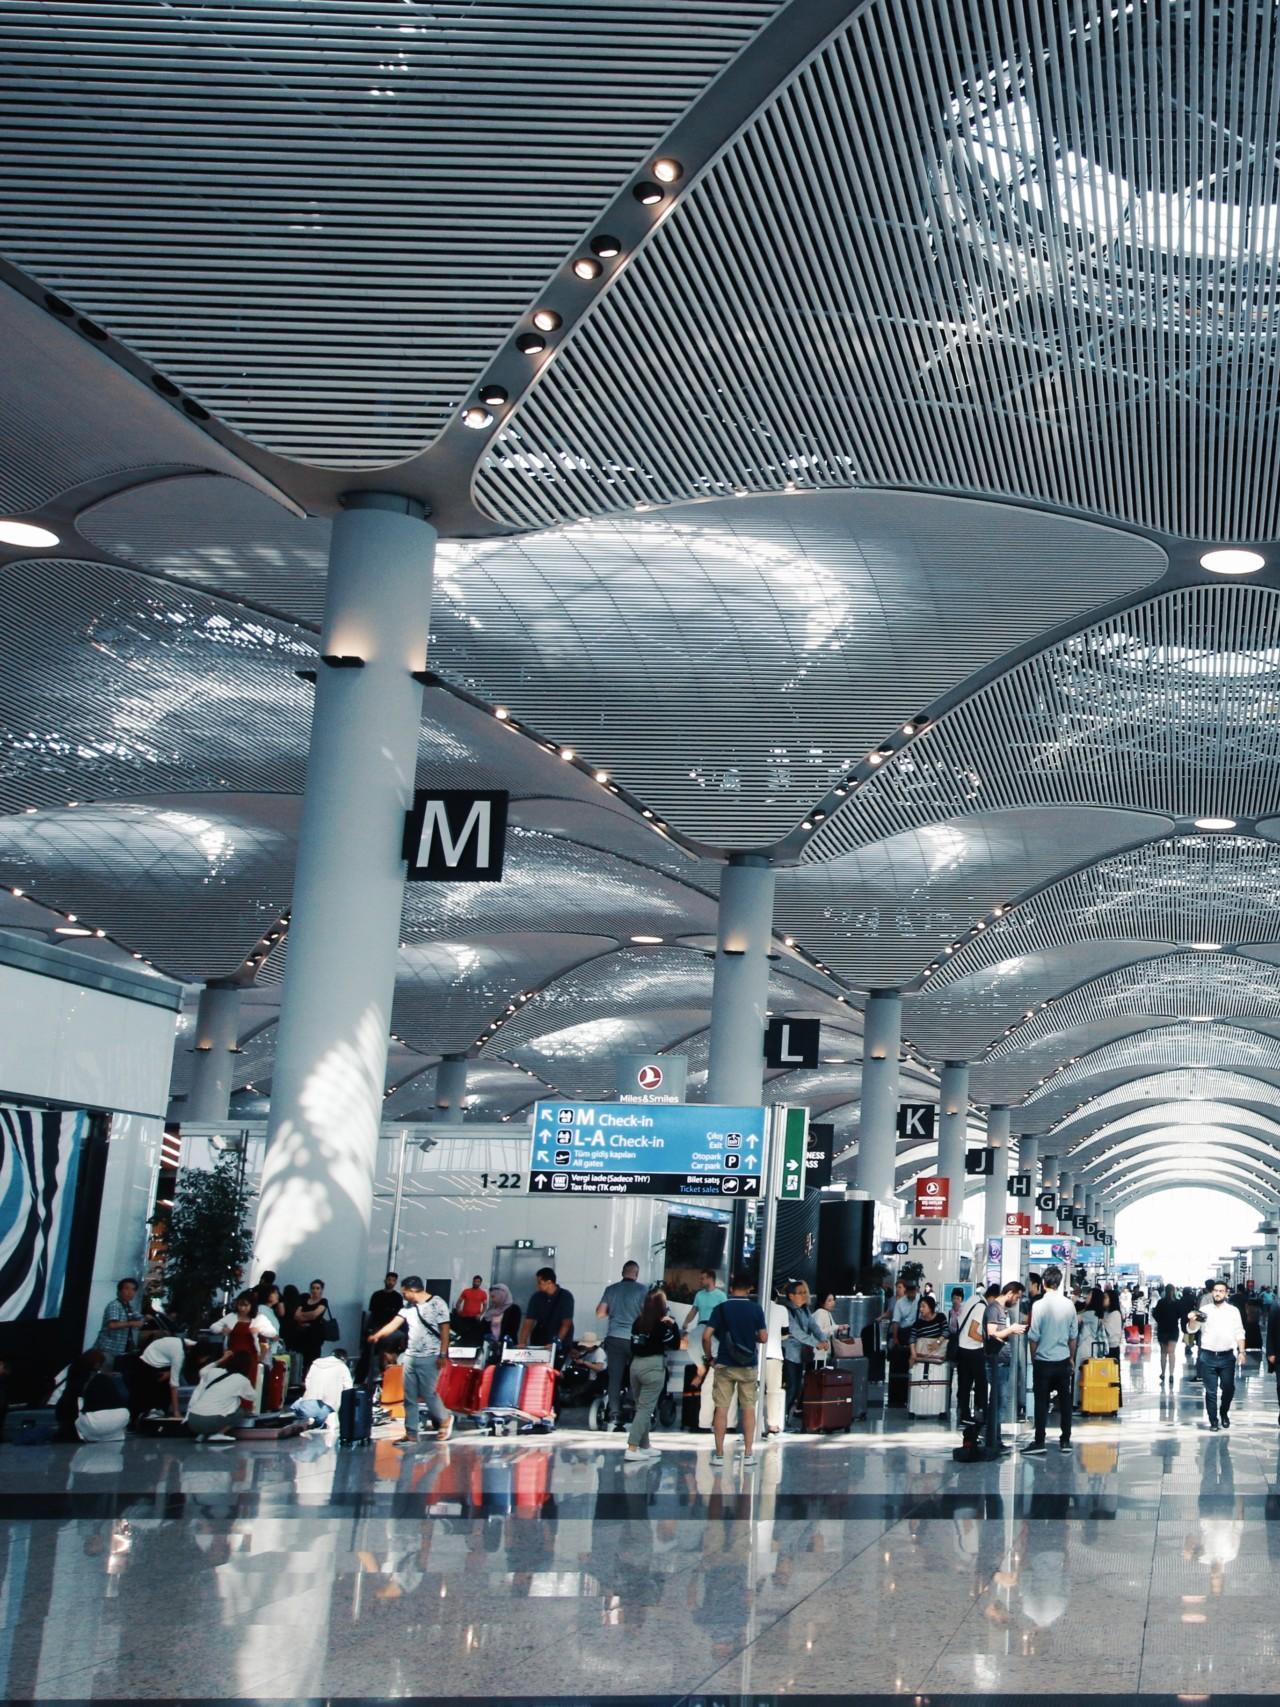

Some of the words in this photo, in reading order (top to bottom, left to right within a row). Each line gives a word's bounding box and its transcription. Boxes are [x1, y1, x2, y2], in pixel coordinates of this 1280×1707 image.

[416, 800, 491, 868] M
[780, 1024, 804, 1062] L
[620, 1094, 679, 1103] Miles&Smiles
[576, 1109, 595, 1126] M
[599, 1113, 654, 1127] Check-in
[905, 1108, 927, 1135] K
[574, 1129, 605, 1147] L-A
[610, 1134, 664, 1148] Check-in
[692, 1152, 721, 1161] Otopark
[975, 1151, 986, 1172] J
[573, 1159, 583, 1167] All
[584, 1160, 604, 1168] gates
[704, 1162, 721, 1171] park
[481, 1173, 521, 1189] 1-22
[571, 1174, 590, 1183] Vergi
[634, 1176, 650, 1184] THY)
[687, 1176, 704, 1184] Bilet
[597, 1184, 609, 1192] (TK
[609, 1184, 627, 1192] only)
[680, 1185, 701, 1193] Ticket
[1012, 1177, 1027, 1195] H
[1040, 1194, 1053, 1210] G
[1061, 1207, 1069, 1219] F
[1076, 1217, 1084, 1228] E
[1087, 1224, 1096, 1234] D
[912, 1228, 927, 1246] K
[1096, 1231, 1104, 1241] C
[1105, 1235, 1111, 1245] B
[1266, 1252, 1274, 1262] 4
